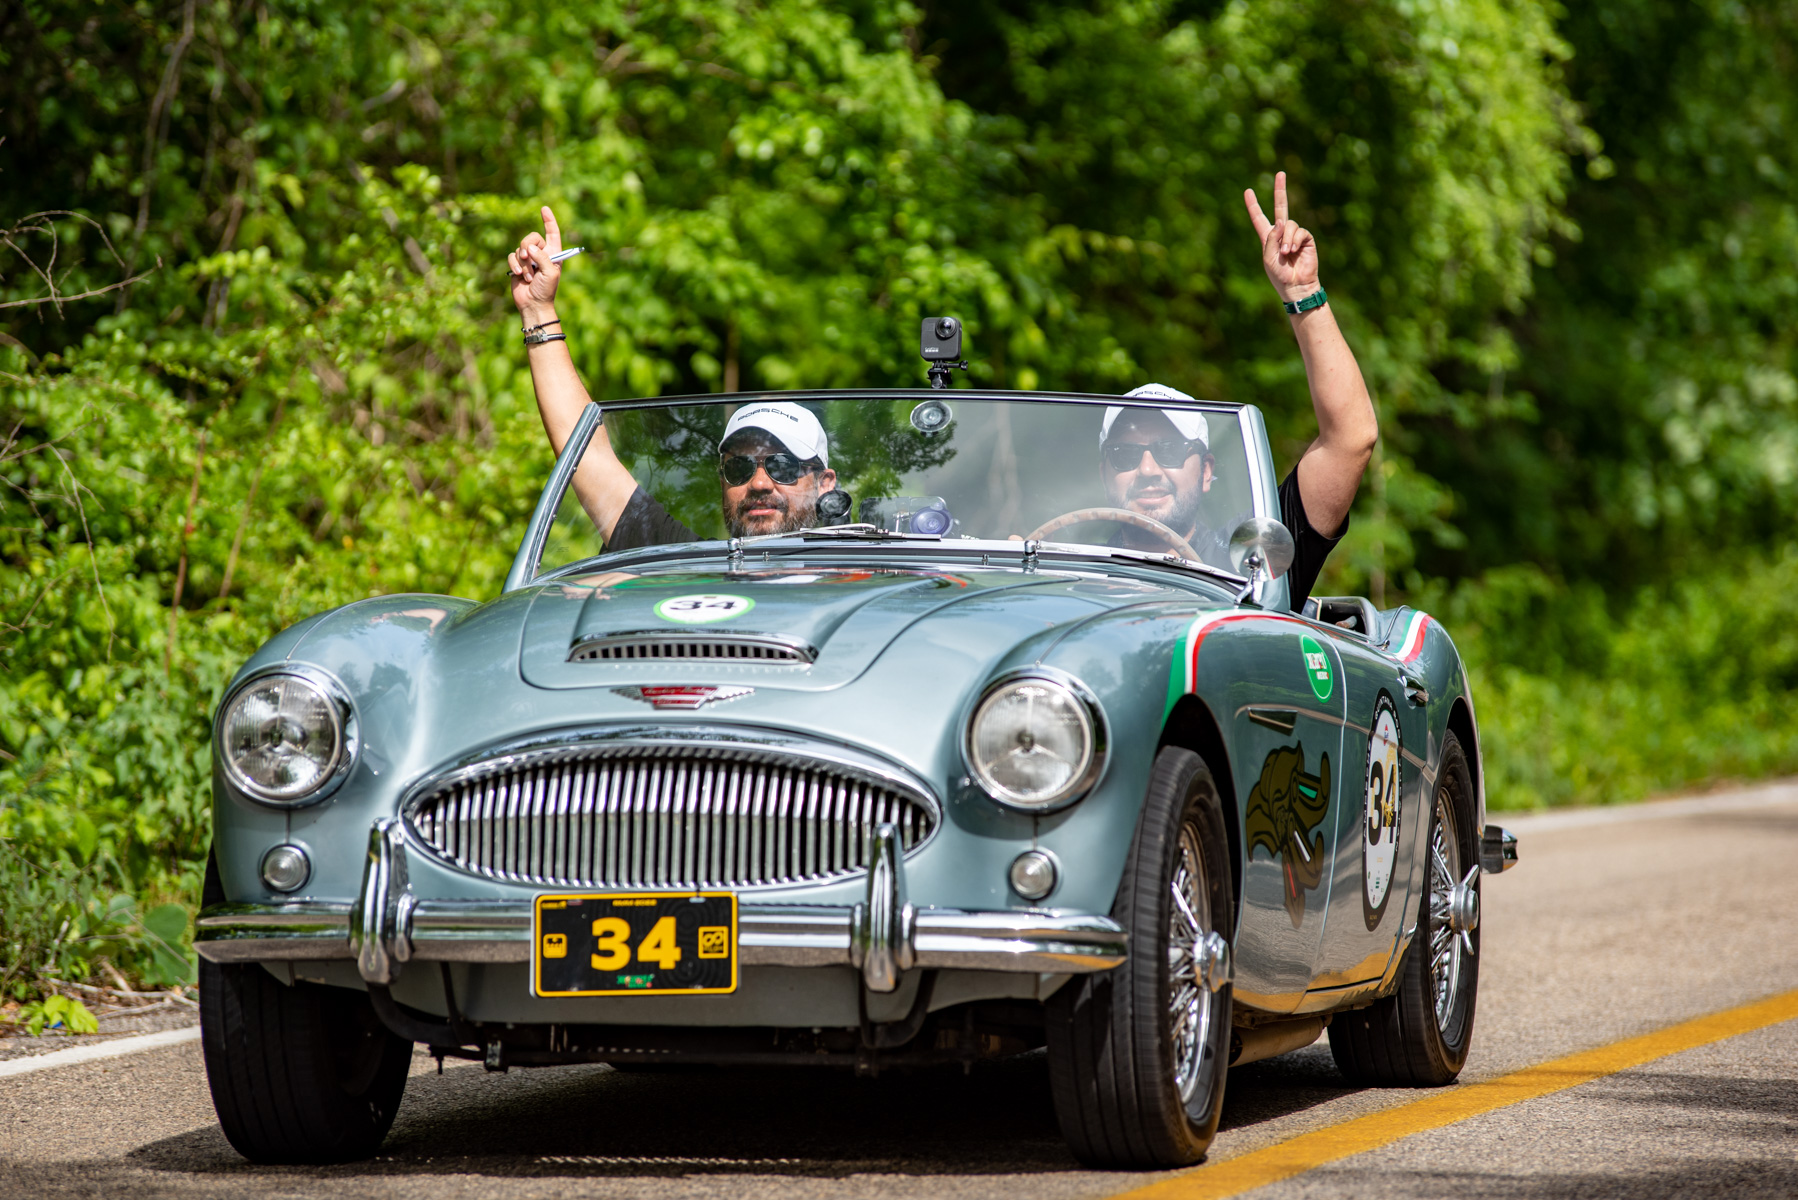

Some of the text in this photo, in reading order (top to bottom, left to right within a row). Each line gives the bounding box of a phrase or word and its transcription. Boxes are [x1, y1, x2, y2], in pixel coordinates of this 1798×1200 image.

[737, 407, 799, 423] PORSCHE
[669, 600, 737, 611] 34
[1368, 760, 1396, 846] 34
[590, 915, 682, 972] 34
